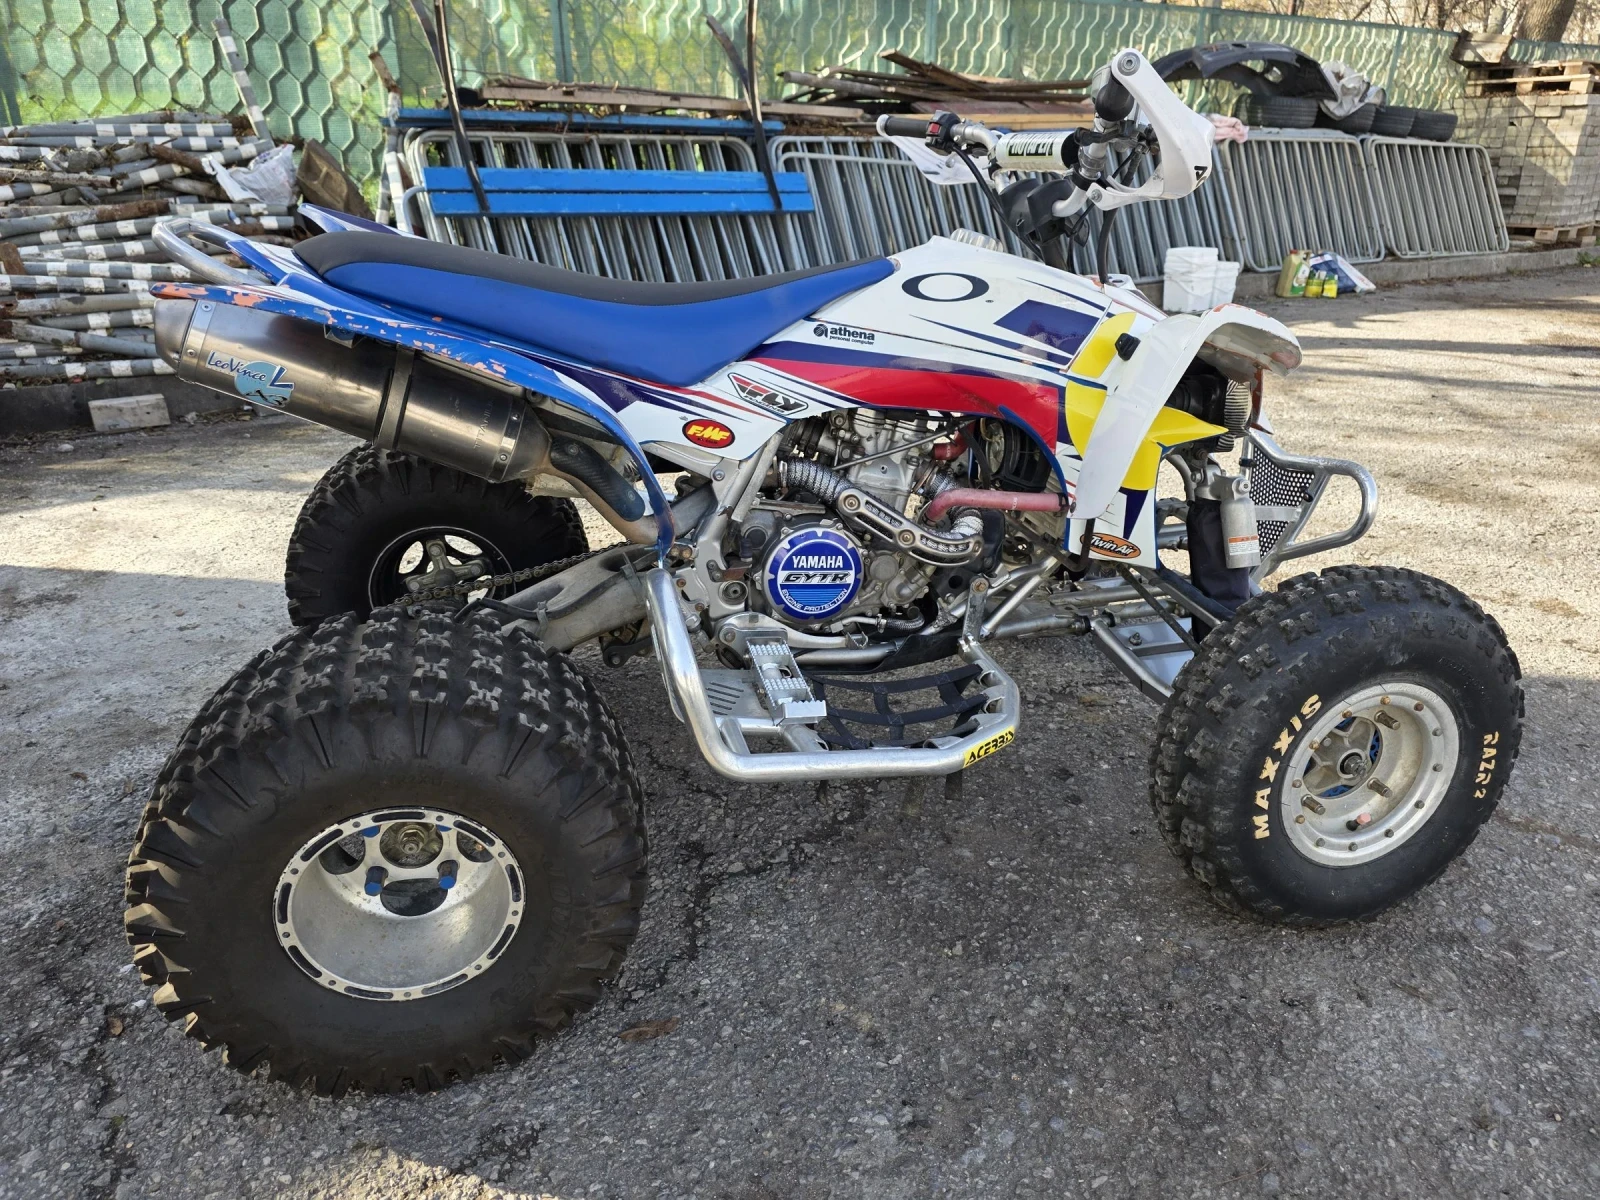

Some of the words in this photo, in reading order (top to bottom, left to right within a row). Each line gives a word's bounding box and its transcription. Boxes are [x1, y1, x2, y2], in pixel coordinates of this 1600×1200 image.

[829, 327, 875, 341] athena
[851, 338, 875, 346] computer
[207, 351, 266, 381] LeoVince
[687, 424, 731, 441] FMF
[1090, 535, 1116, 551] Twin
[1115, 544, 1135, 555] Air
[792, 555, 844, 569] YAMAHA
[782, 571, 851, 584] GYTR
[781, 588, 804, 610] ENGINE
[803, 588, 848, 612] PROTECTION
[1475, 731, 1500, 785] RAZR
[1252, 694, 1322, 840] MAXXIS
[1473, 788, 1487, 799] 2
